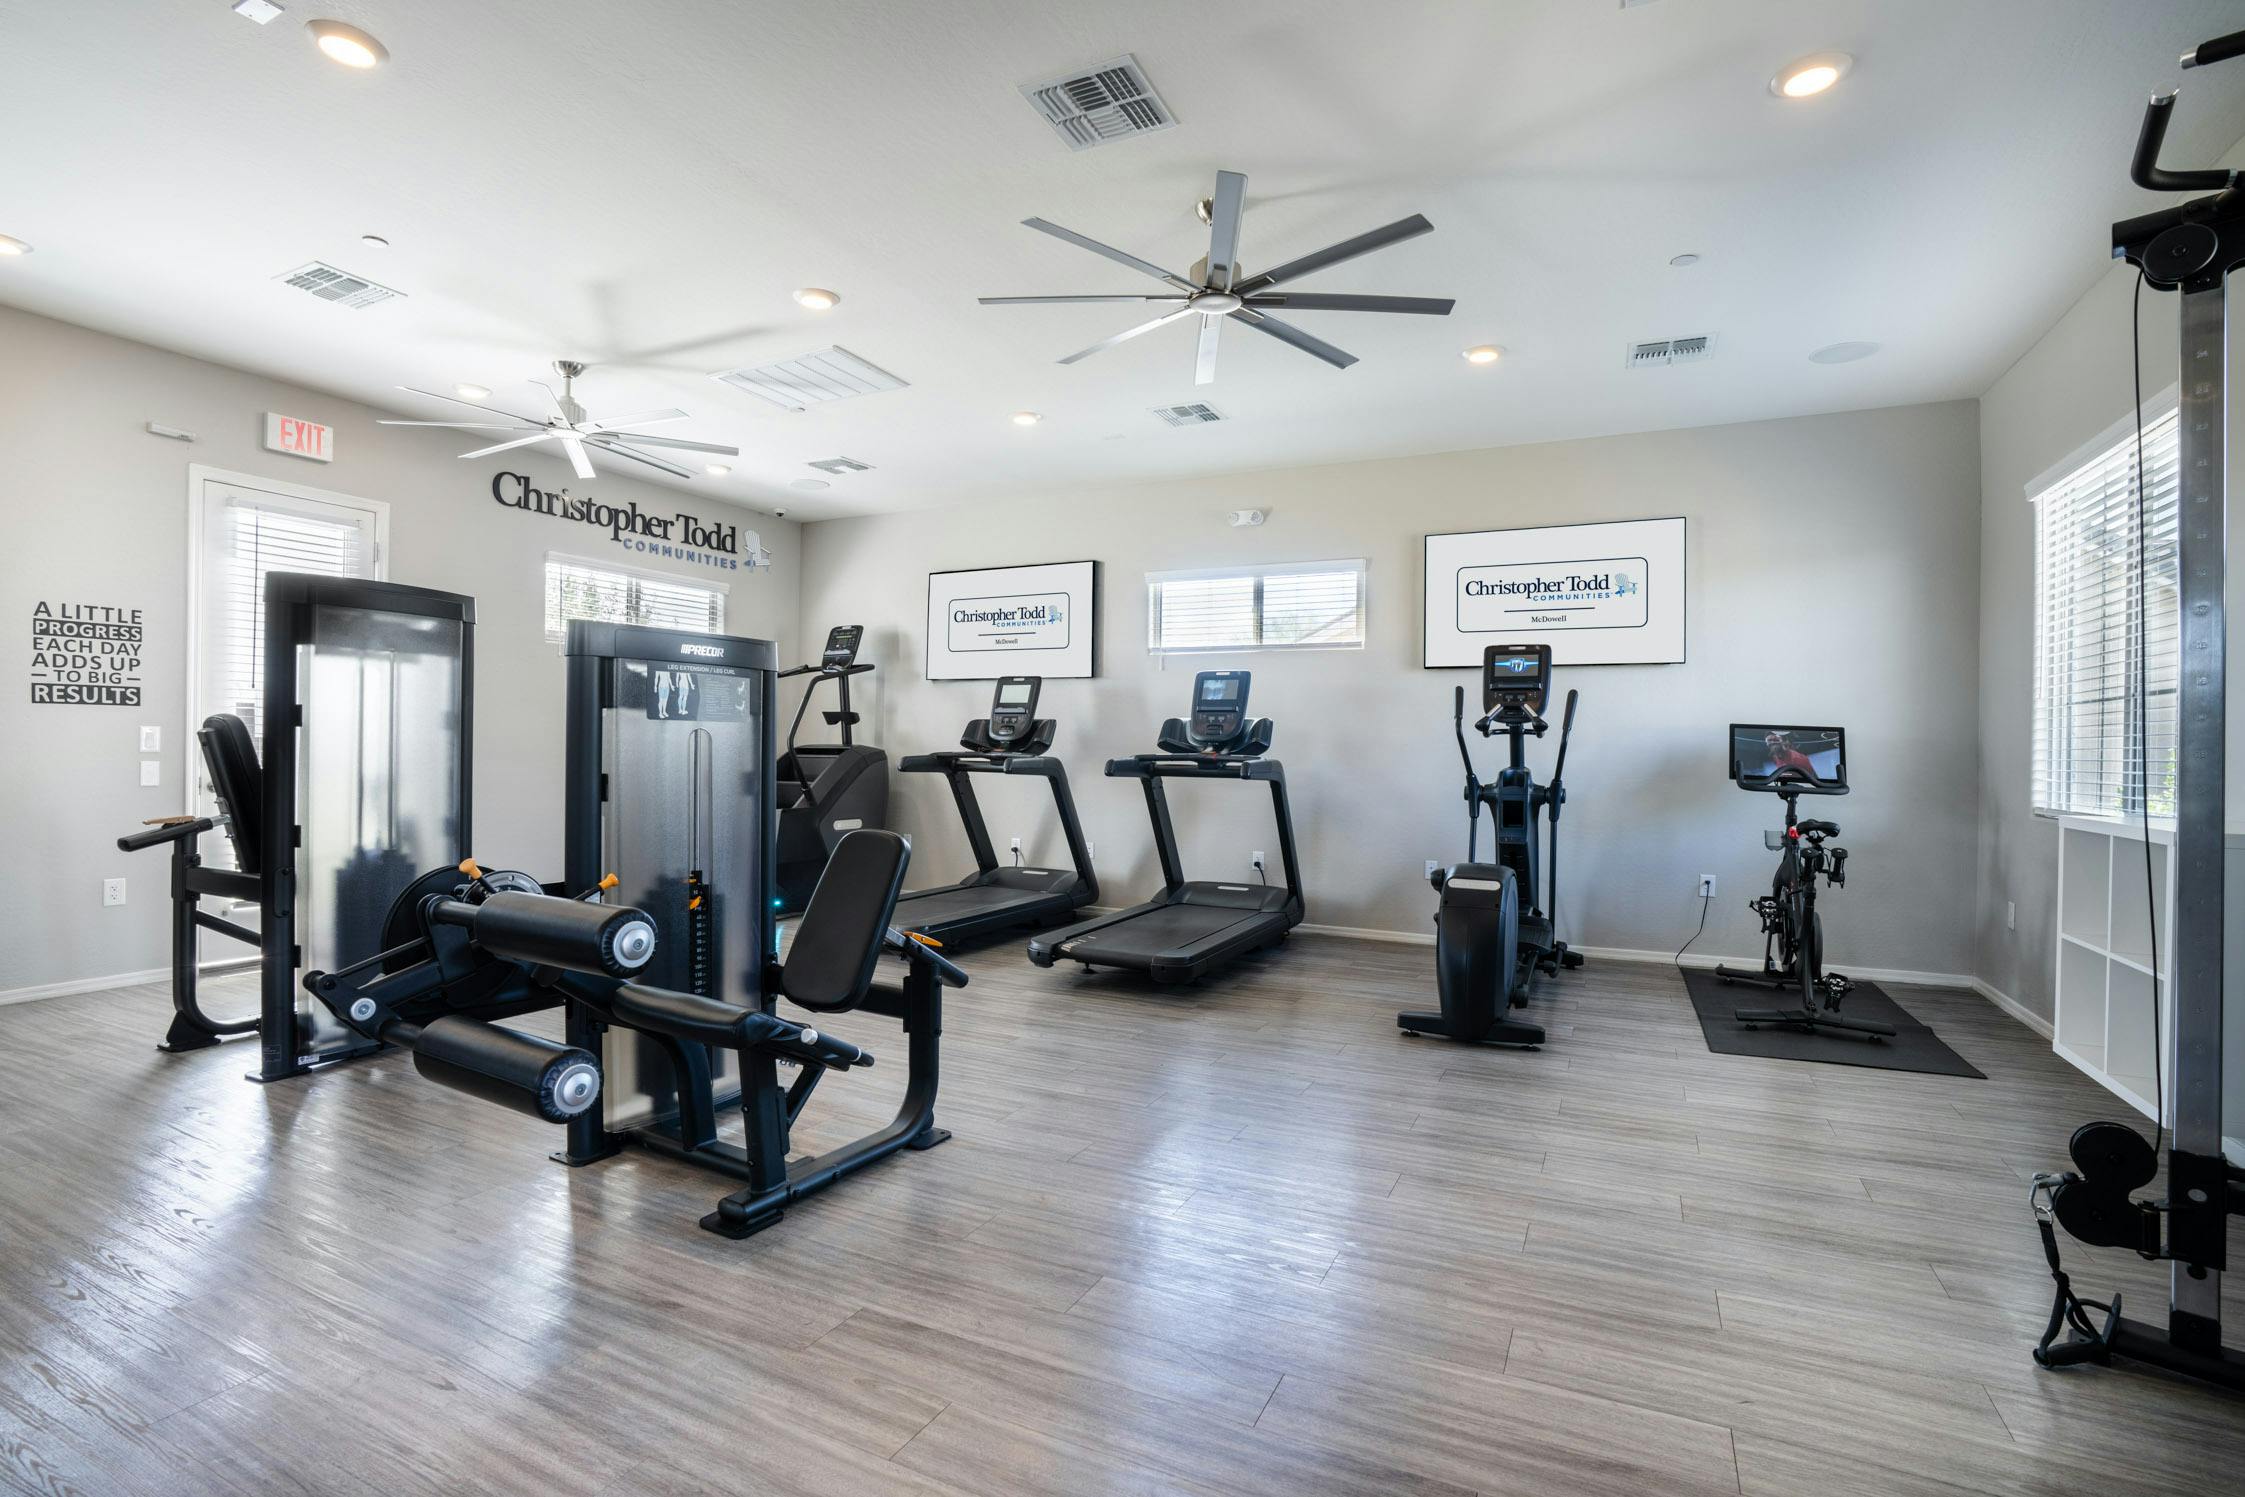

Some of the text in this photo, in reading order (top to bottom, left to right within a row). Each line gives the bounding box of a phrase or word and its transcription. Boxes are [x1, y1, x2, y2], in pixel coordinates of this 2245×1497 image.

[280, 416, 325, 456] EXIT
[492, 471, 738, 554] Christopher Todd
[623, 538, 738, 570] COMMUNITIES
[1465, 574, 1610, 599] Christopher Todd
[1532, 592, 1611, 602] COMMUNITIES
[33, 601, 142, 625] A LITTLE
[953, 605, 1046, 626] Christopher Todd
[1531, 615, 1567, 623] McDowell
[34, 620, 141, 641] PROGRESS
[996, 620, 1046, 628] COMMUNITIES
[33, 637, 142, 657] EACH DAY
[687, 644, 724, 657] PRECOR
[32, 653, 141, 671] ADDS UP
[680, 665, 709, 673] EXTENSION
[53, 669, 122, 685] TO BIG
[34, 684, 139, 705] RESULTS
